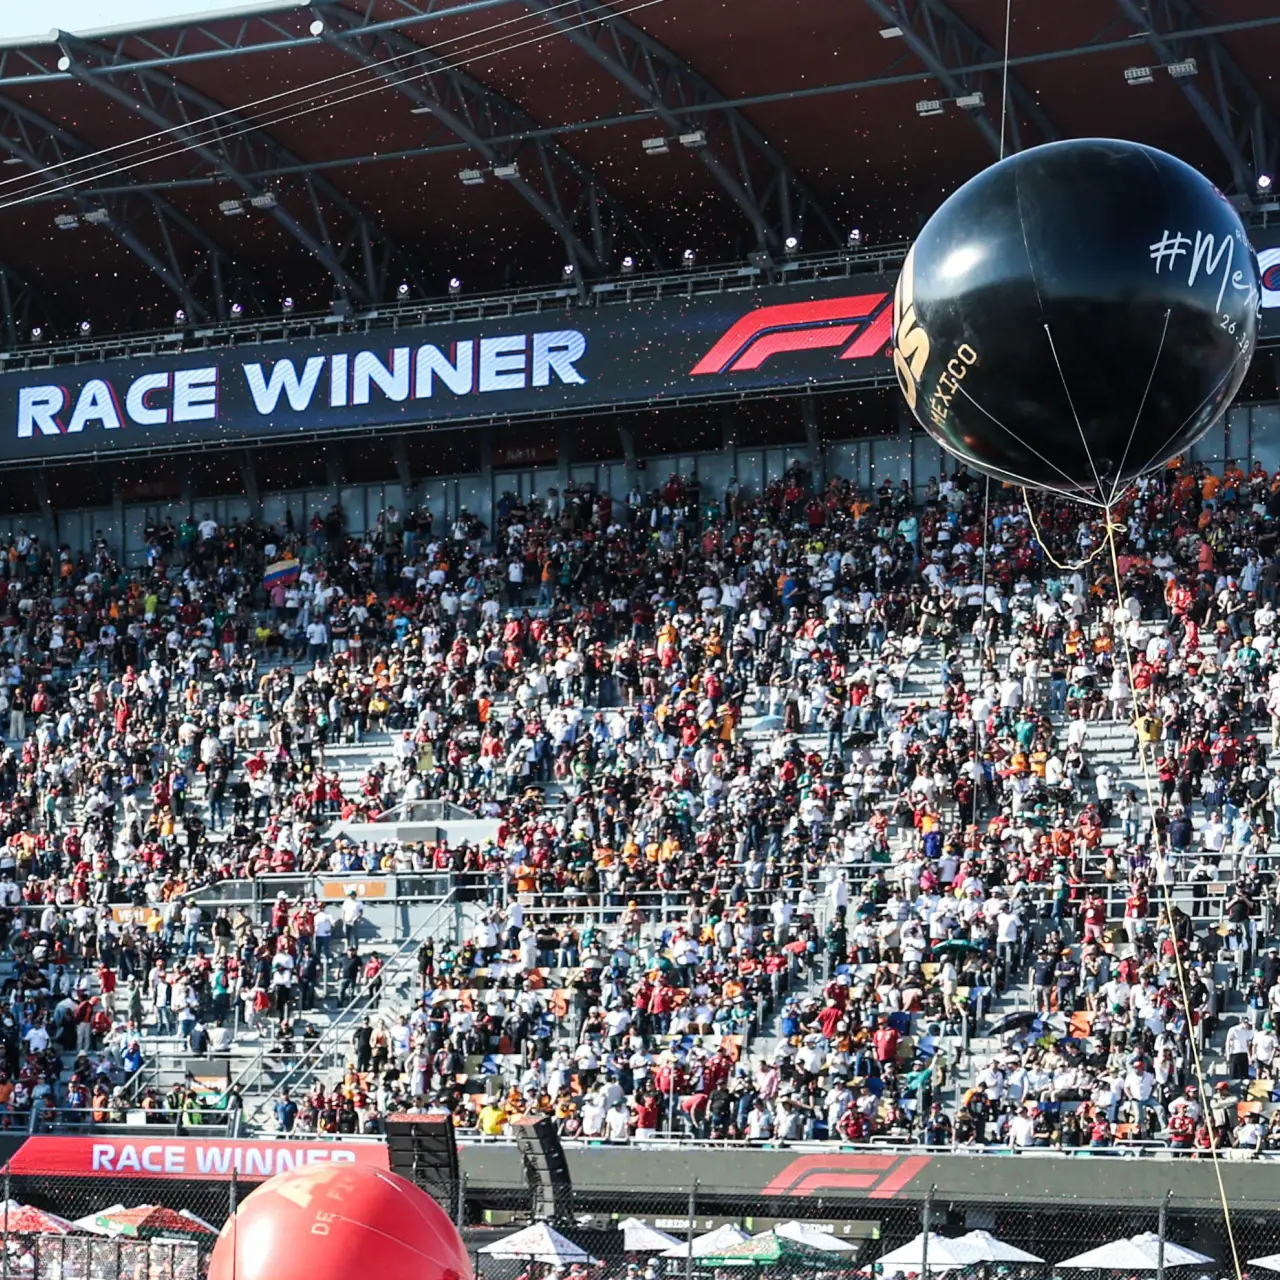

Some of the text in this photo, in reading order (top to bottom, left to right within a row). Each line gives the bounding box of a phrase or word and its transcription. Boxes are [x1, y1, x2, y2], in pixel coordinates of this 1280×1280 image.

[17, 330, 586, 438] RACE WINNER
[92, 1144, 186, 1173] RACE
